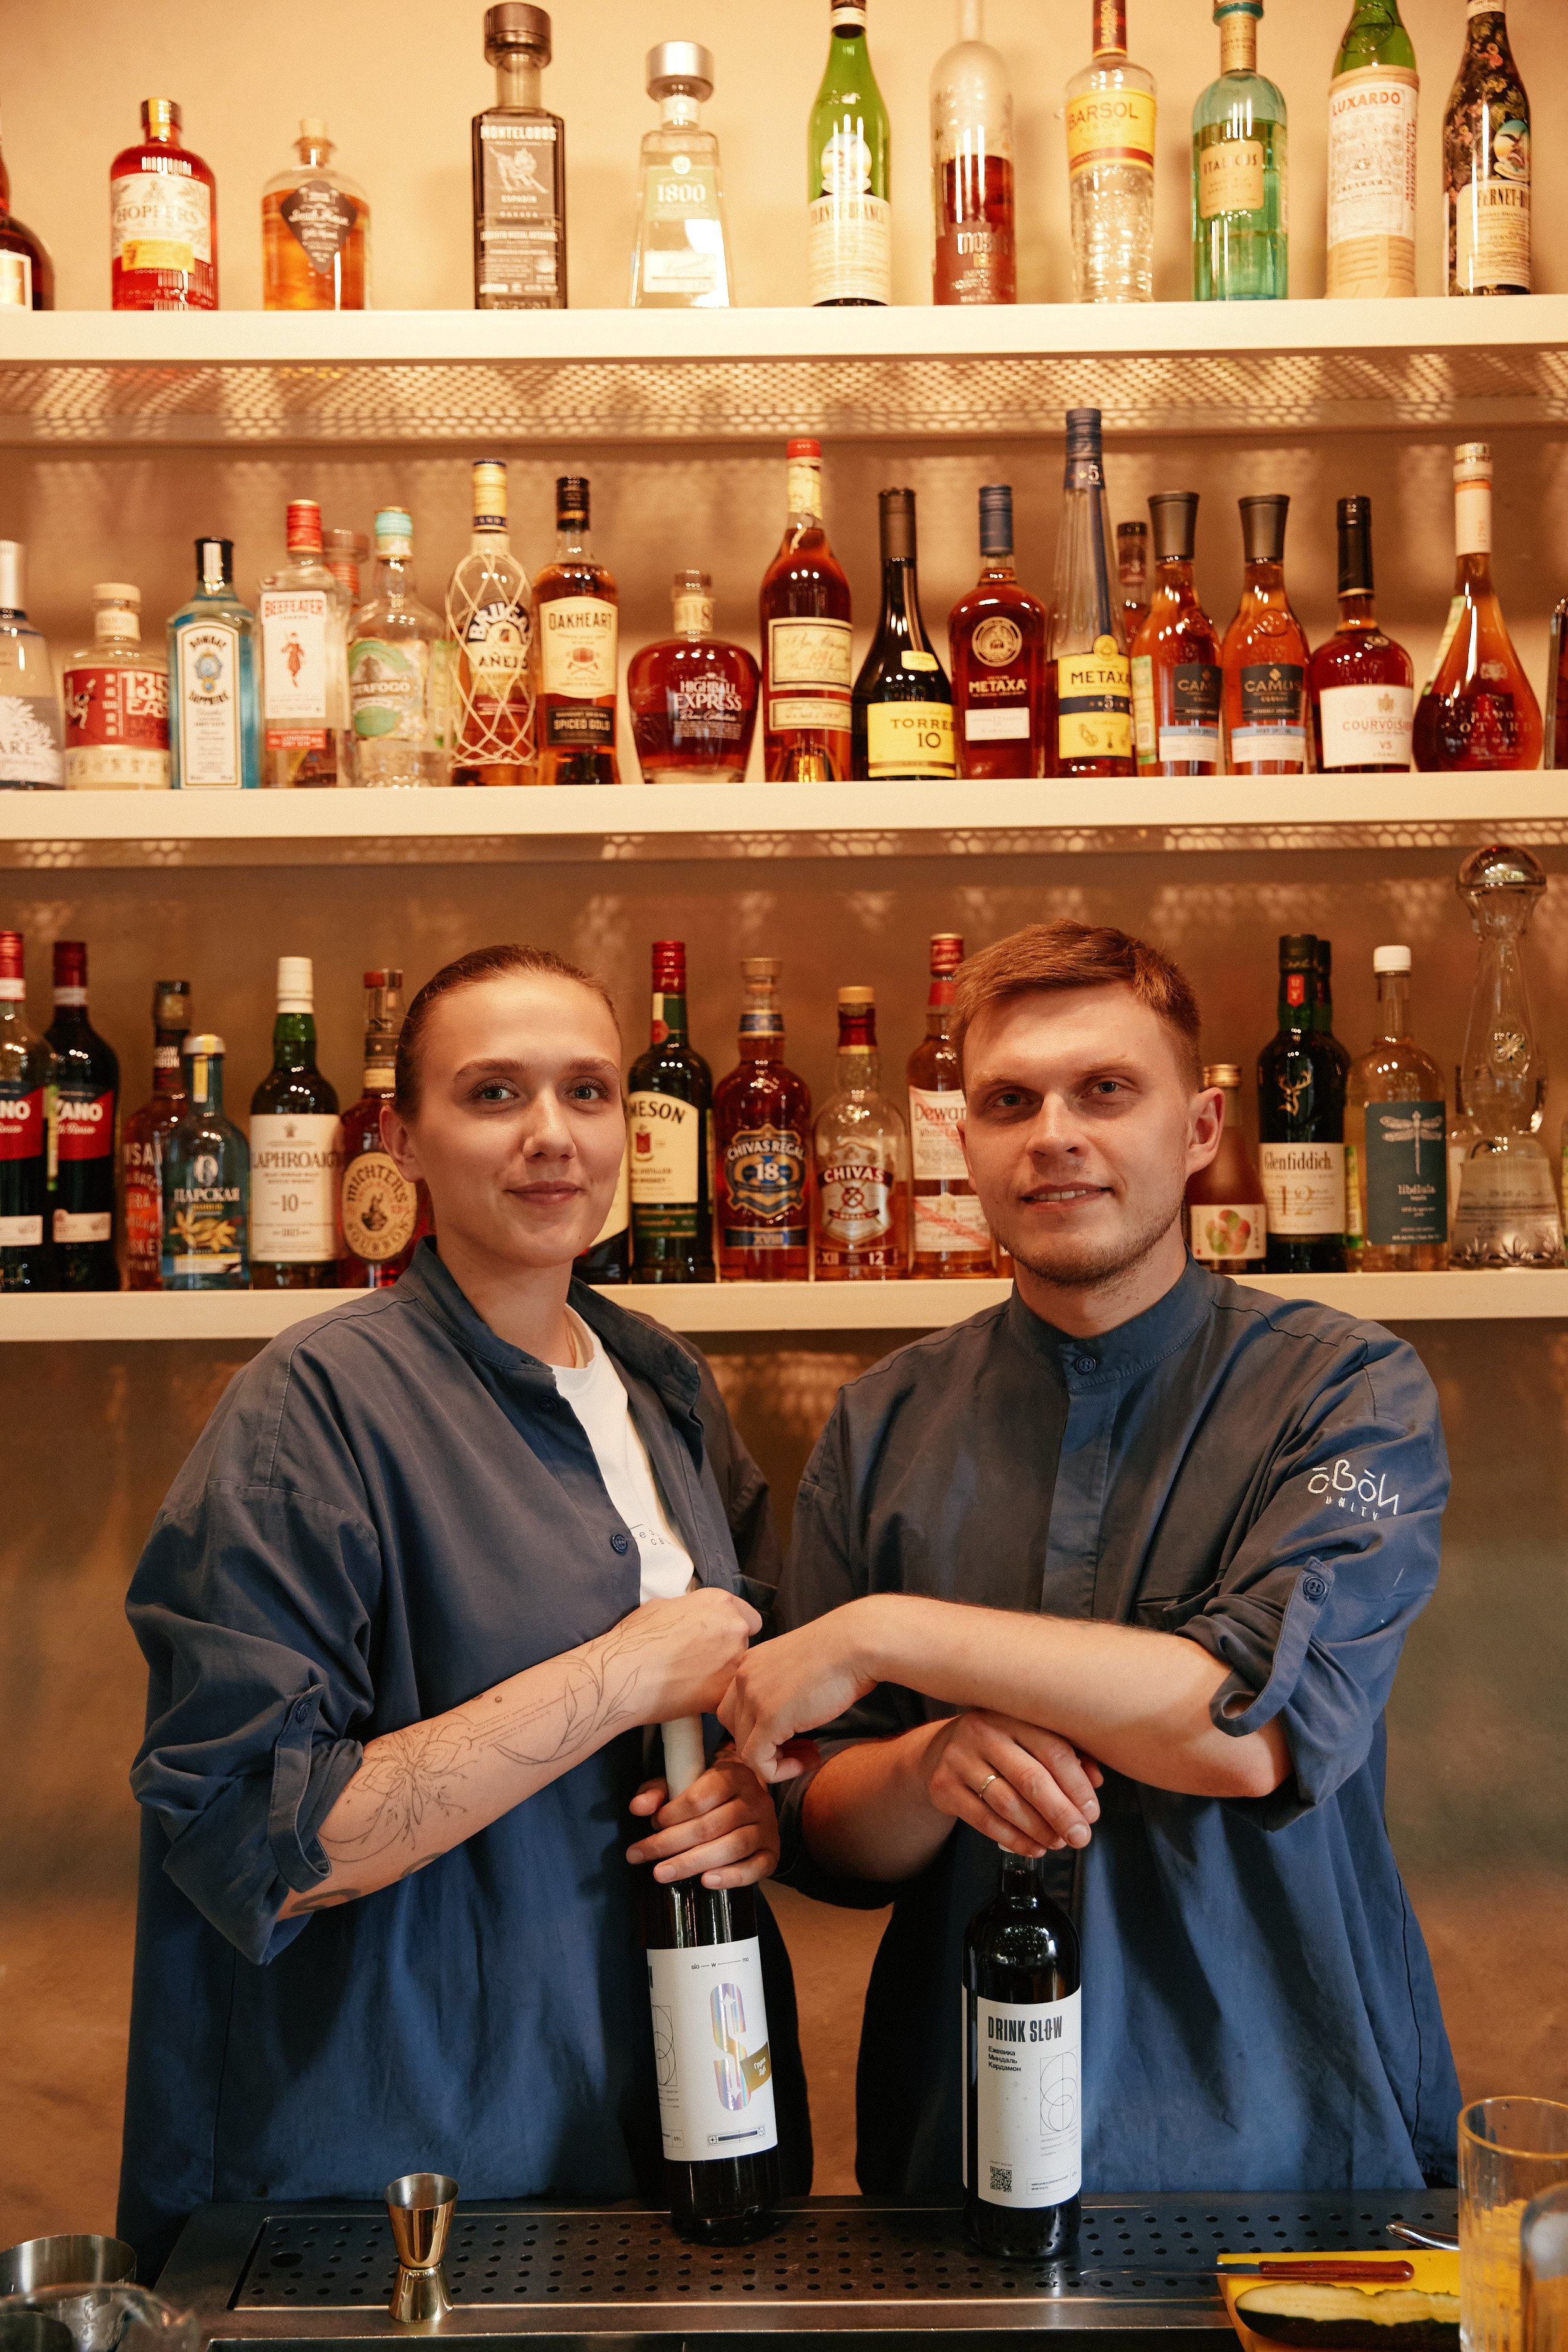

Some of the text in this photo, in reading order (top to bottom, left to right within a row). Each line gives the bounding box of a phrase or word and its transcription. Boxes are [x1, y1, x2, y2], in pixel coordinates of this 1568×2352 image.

[1332, 92, 1402, 117] LUXARDO
[1067, 102, 1139, 131] BARSOL
[480, 125, 557, 141] MONTELOBOS
[1203, 154, 1258, 175] ITALICUS
[655, 183, 706, 203] 1800
[117, 204, 199, 225] HOPPERS
[1088, 464, 1099, 482] 5
[265, 599, 324, 618] BEEFEATER
[549, 612, 612, 631] OAKHEART
[679, 680, 736, 695] HIGHBALL
[969, 678, 1027, 694] METAXA
[1244, 679, 1302, 693] CAMUS
[674, 692, 743, 712] EXPRESS
[1104, 694, 1114, 709] 5
[553, 718, 610, 731] SPICED GOLD
[918, 732, 941, 748] 10
[726, 1139, 805, 1161] CHIVAS REGAL
[1264, 1150, 1332, 1171] Glenfiddich
[755, 1161, 781, 1182] 18
[823, 1166, 885, 1184] CHIVAS
[282, 1193, 299, 1212] 10
[1279, 1184, 1315, 1217] 12
[869, 1251, 886, 1266] 12
[987, 2015, 1063, 2043] DRINK SLOW
[987, 2045, 1016, 2057] Ежевика
[987, 2053, 1018, 2065] Миндаль
[987, 2061, 1022, 2072] Кардамон
